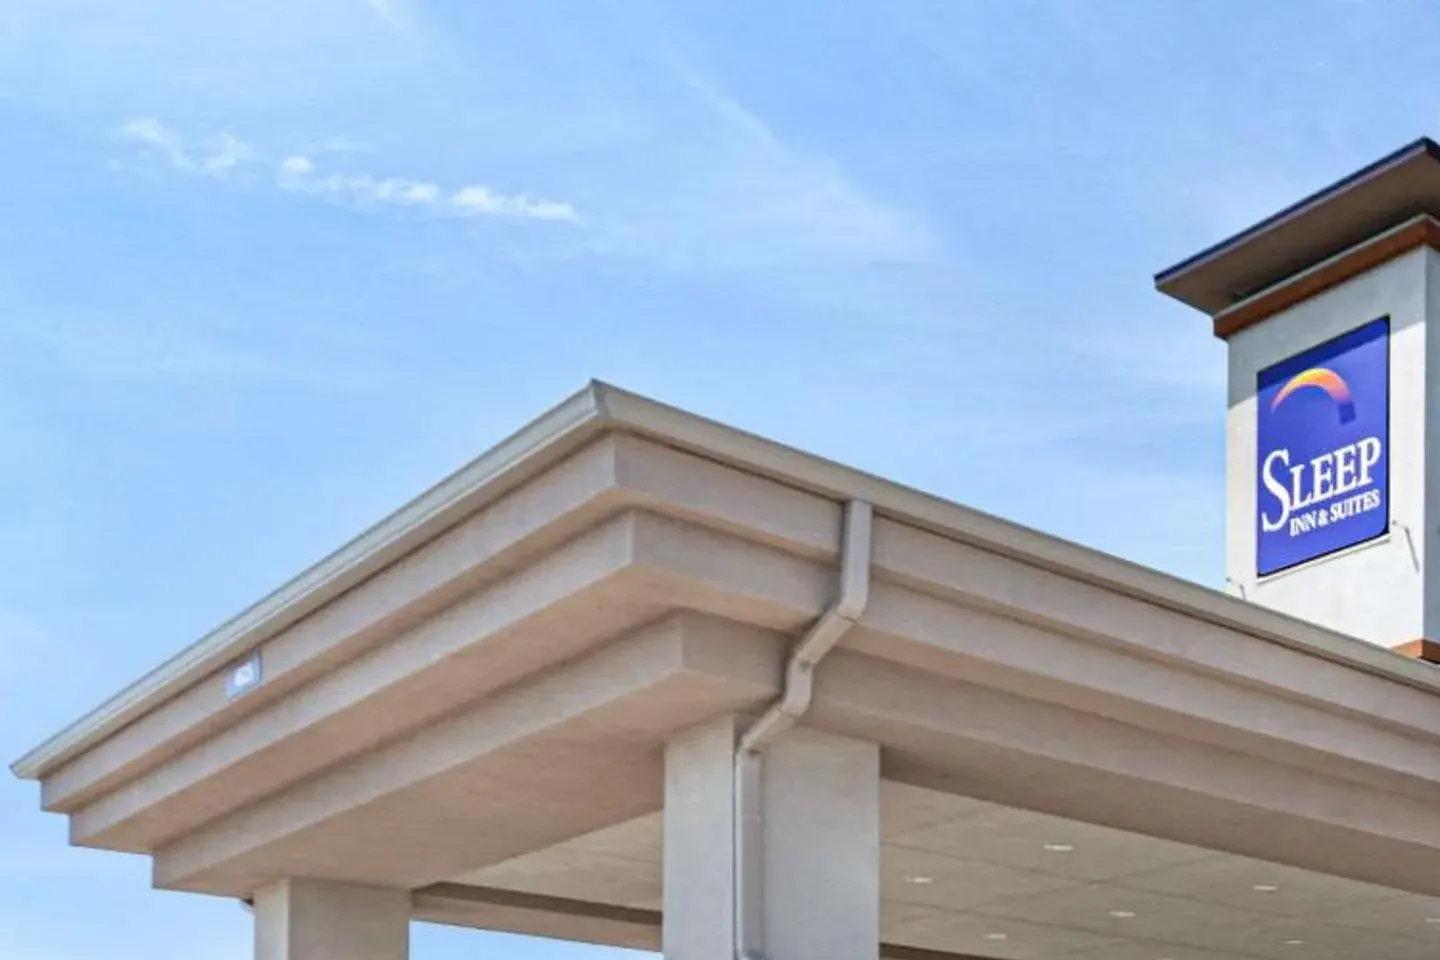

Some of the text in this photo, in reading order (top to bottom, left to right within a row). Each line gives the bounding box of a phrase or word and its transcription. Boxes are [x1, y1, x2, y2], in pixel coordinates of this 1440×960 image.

[1262, 437, 1381, 532] SLEEP
[1290, 489, 1380, 536] INN & SUITES
